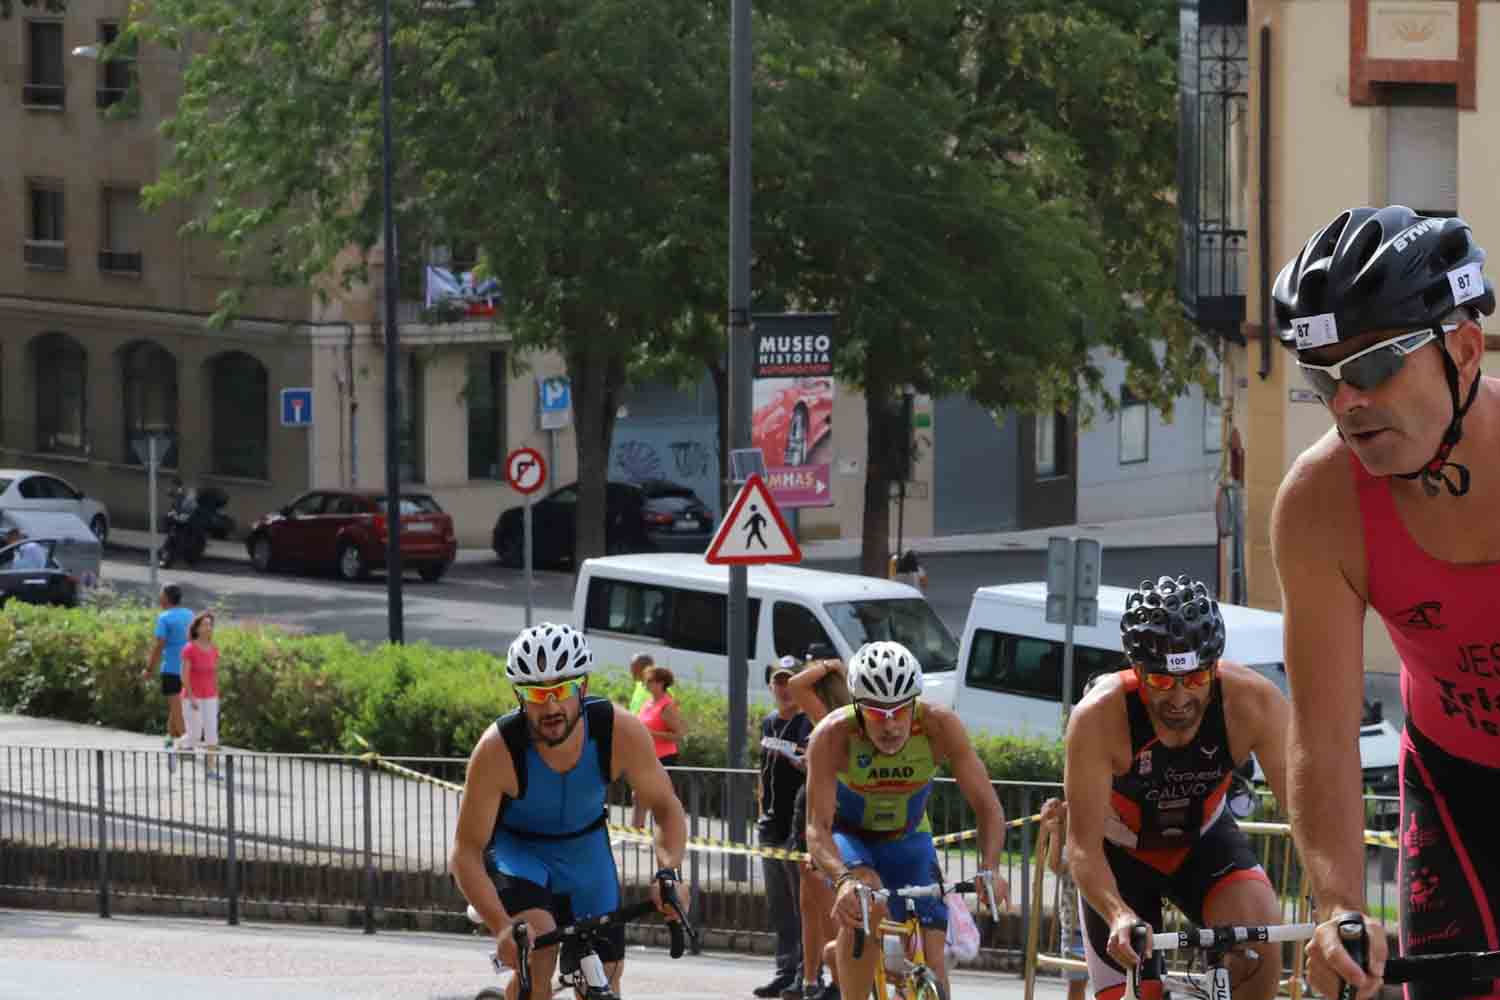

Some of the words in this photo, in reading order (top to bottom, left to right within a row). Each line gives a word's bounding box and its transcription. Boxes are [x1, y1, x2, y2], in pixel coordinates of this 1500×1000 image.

[1457, 273, 1471, 290] 87
[759, 335, 830, 353] MUSEO
[759, 353, 831, 365] HISTORIA
[867, 766, 915, 780] ABAD
[1145, 783, 1208, 801] CALVO
